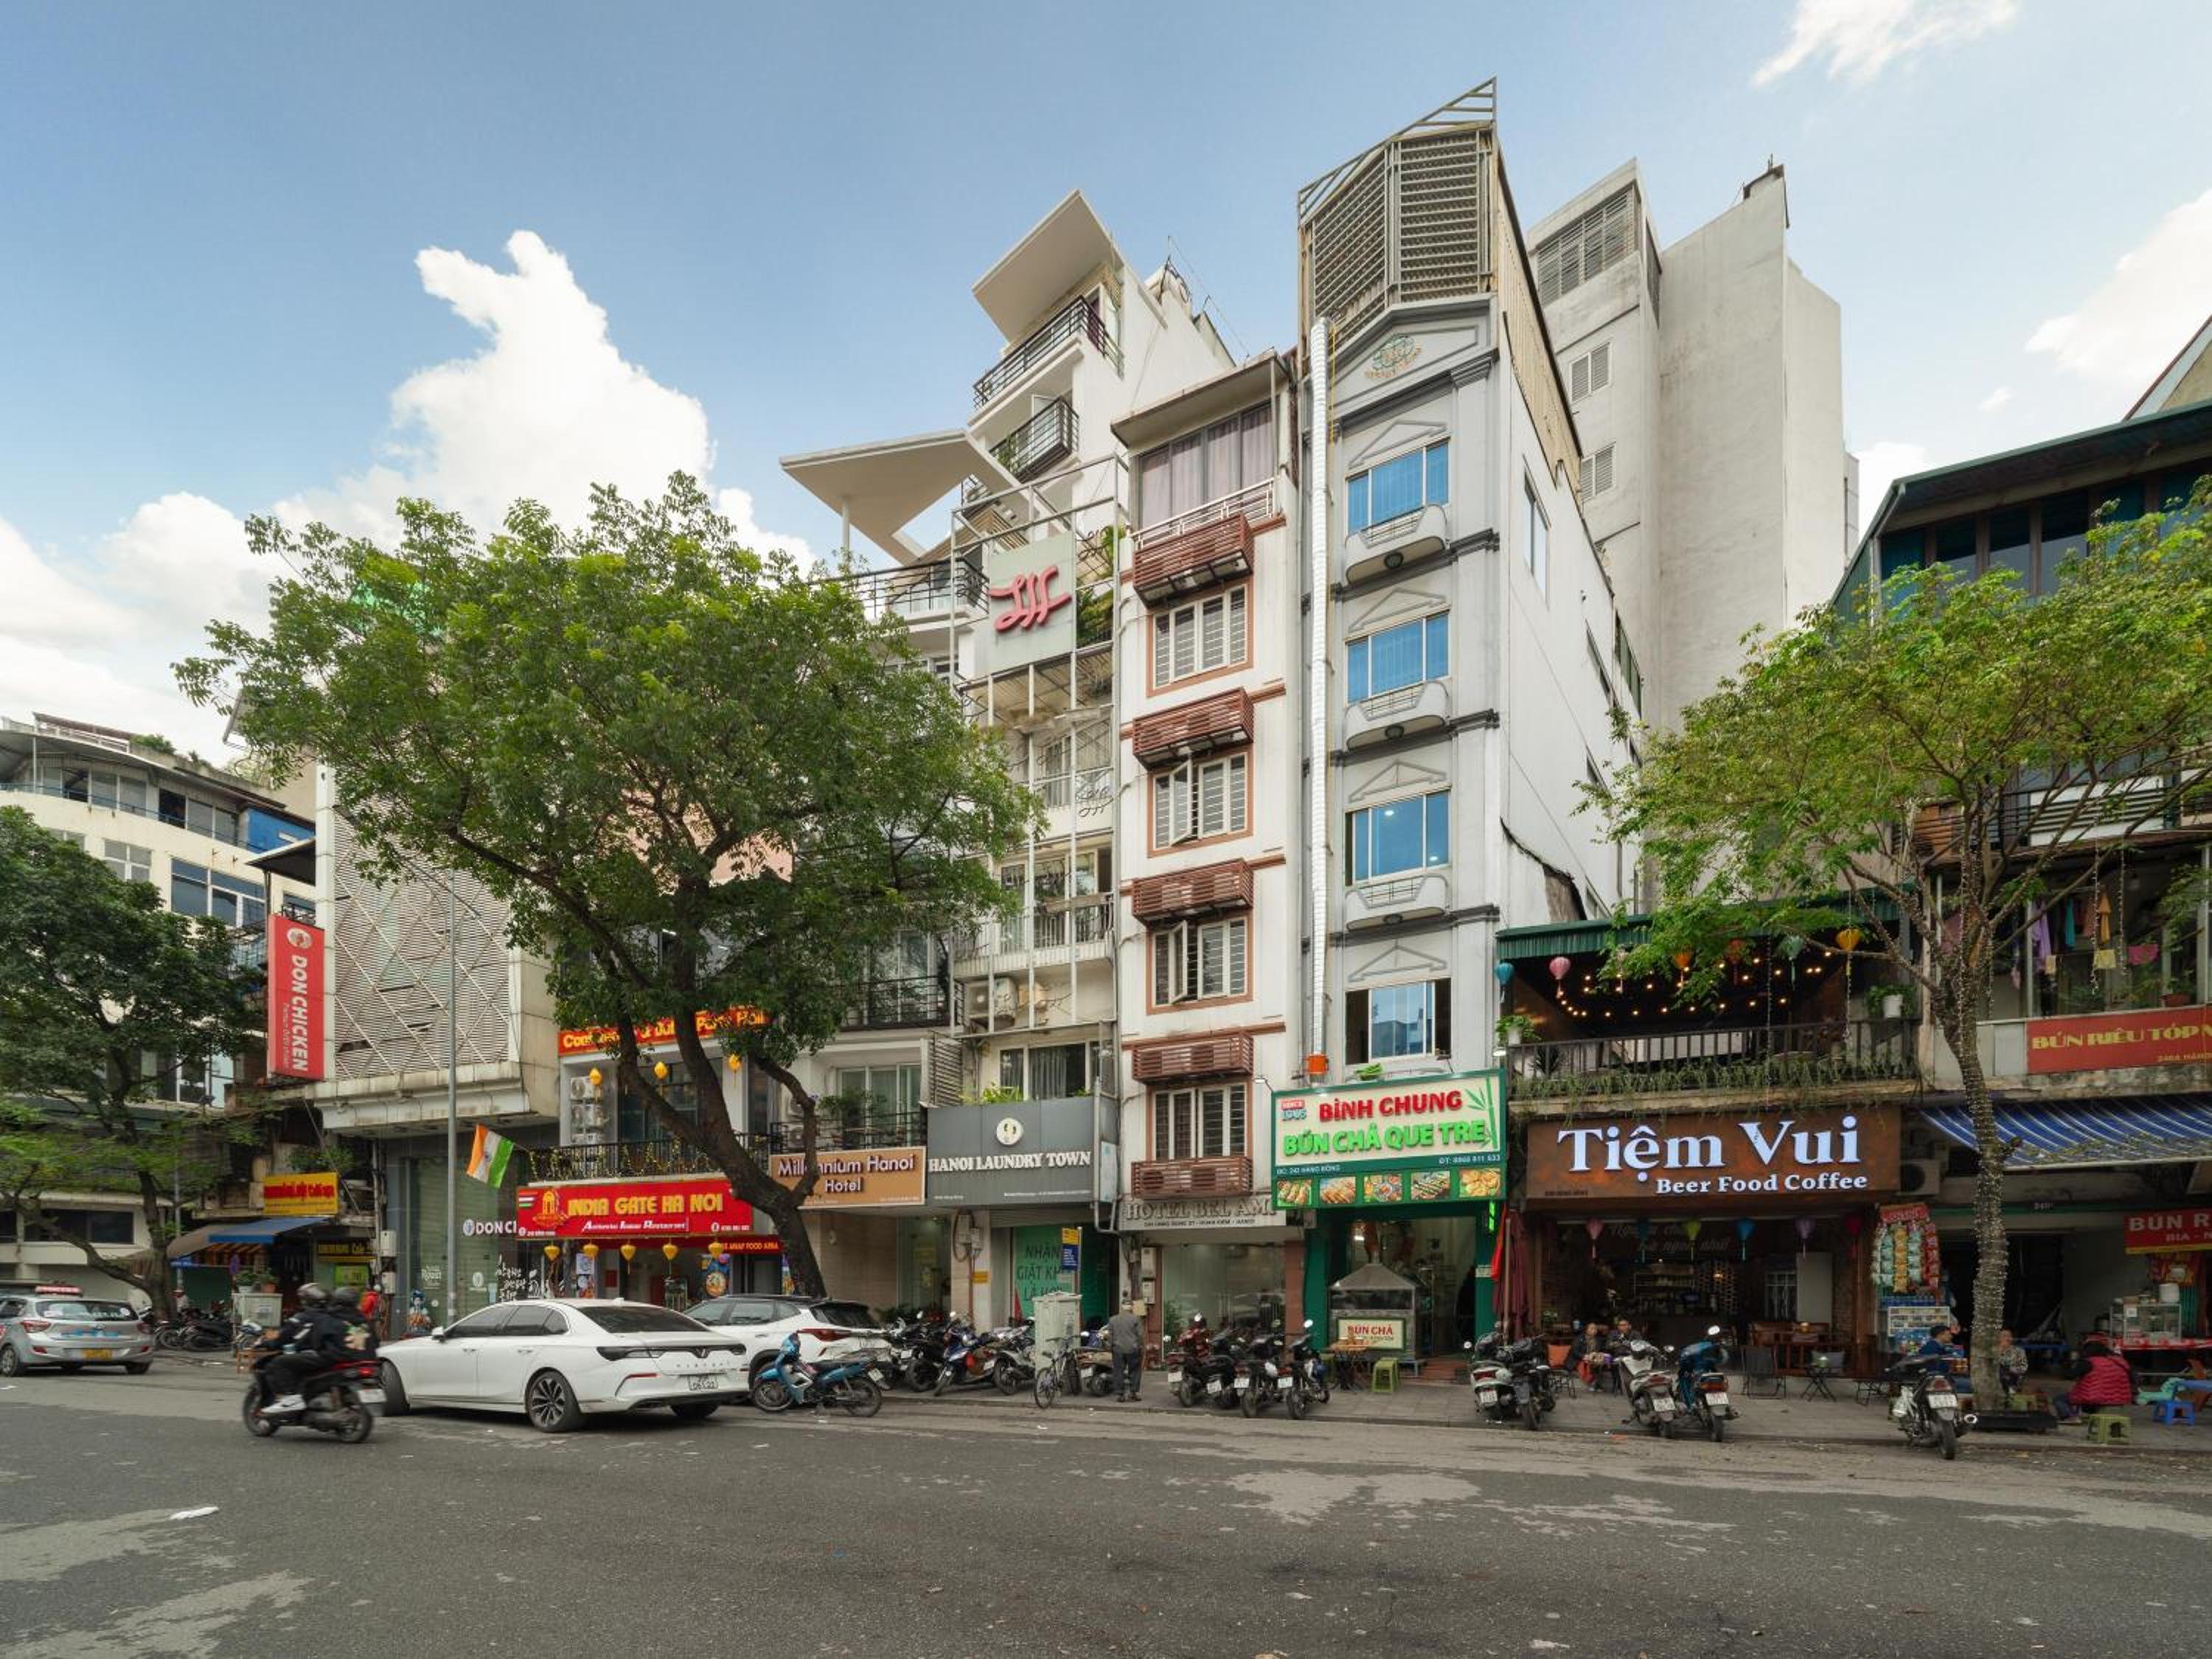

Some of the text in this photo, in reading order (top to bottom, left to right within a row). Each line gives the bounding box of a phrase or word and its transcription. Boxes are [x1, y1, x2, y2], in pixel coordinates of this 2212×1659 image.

[291, 955, 307, 1071] DON CHICKEN
[1379, 1090, 1463, 1114] CHUNG
[1283, 1119, 1486, 1156] BÚN CHẢ QUE TRE
[1557, 1115, 1861, 1182] Tiệm Vui
[866, 1154, 914, 1172] Hanoi
[928, 1151, 1091, 1172] HANOI LAUNDRY TOWN
[824, 1178, 862, 1192] Hotel
[1656, 1172, 1867, 1194] Beer Food Coffee
[568, 1193, 723, 1216] INDIA GATE HA NOI
[1126, 1202, 1192, 1220] HOTEL
[1194, 1198, 1232, 1217] BEL
[476, 1221, 503, 1234] DON
[746, 1242, 762, 1250] FOOD
